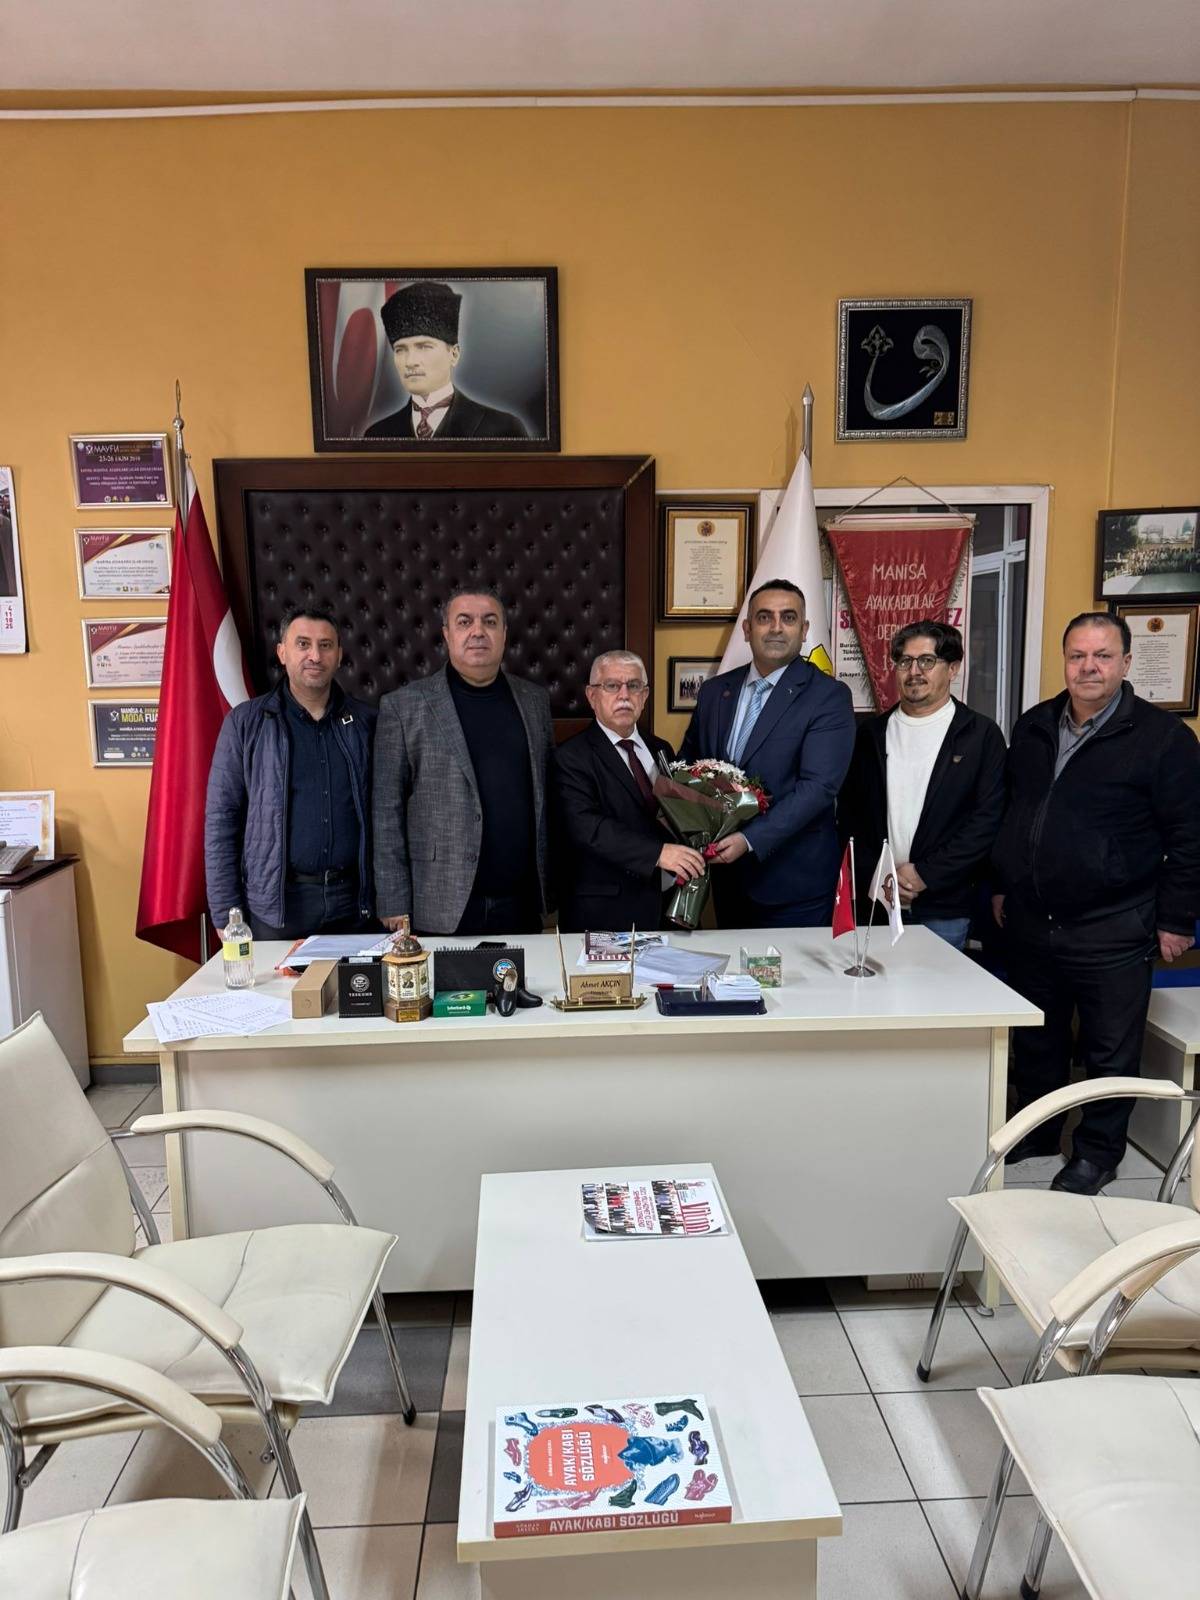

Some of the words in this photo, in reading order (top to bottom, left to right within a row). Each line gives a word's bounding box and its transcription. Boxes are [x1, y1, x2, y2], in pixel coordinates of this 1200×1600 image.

[872, 563, 927, 580] MANİSA
[864, 593, 936, 611] AYAKKABICILAR
[121, 713, 144, 722] MODA
[145, 713, 158, 722] FUA
[561, 1429, 577, 1486] AYAK/KABI
[576, 1431, 595, 1481] SÖZLÜĞÜ
[550, 1518, 616, 1533] AYAK/KABI
[619, 1510, 679, 1527] SÖZLÜĞÜ
